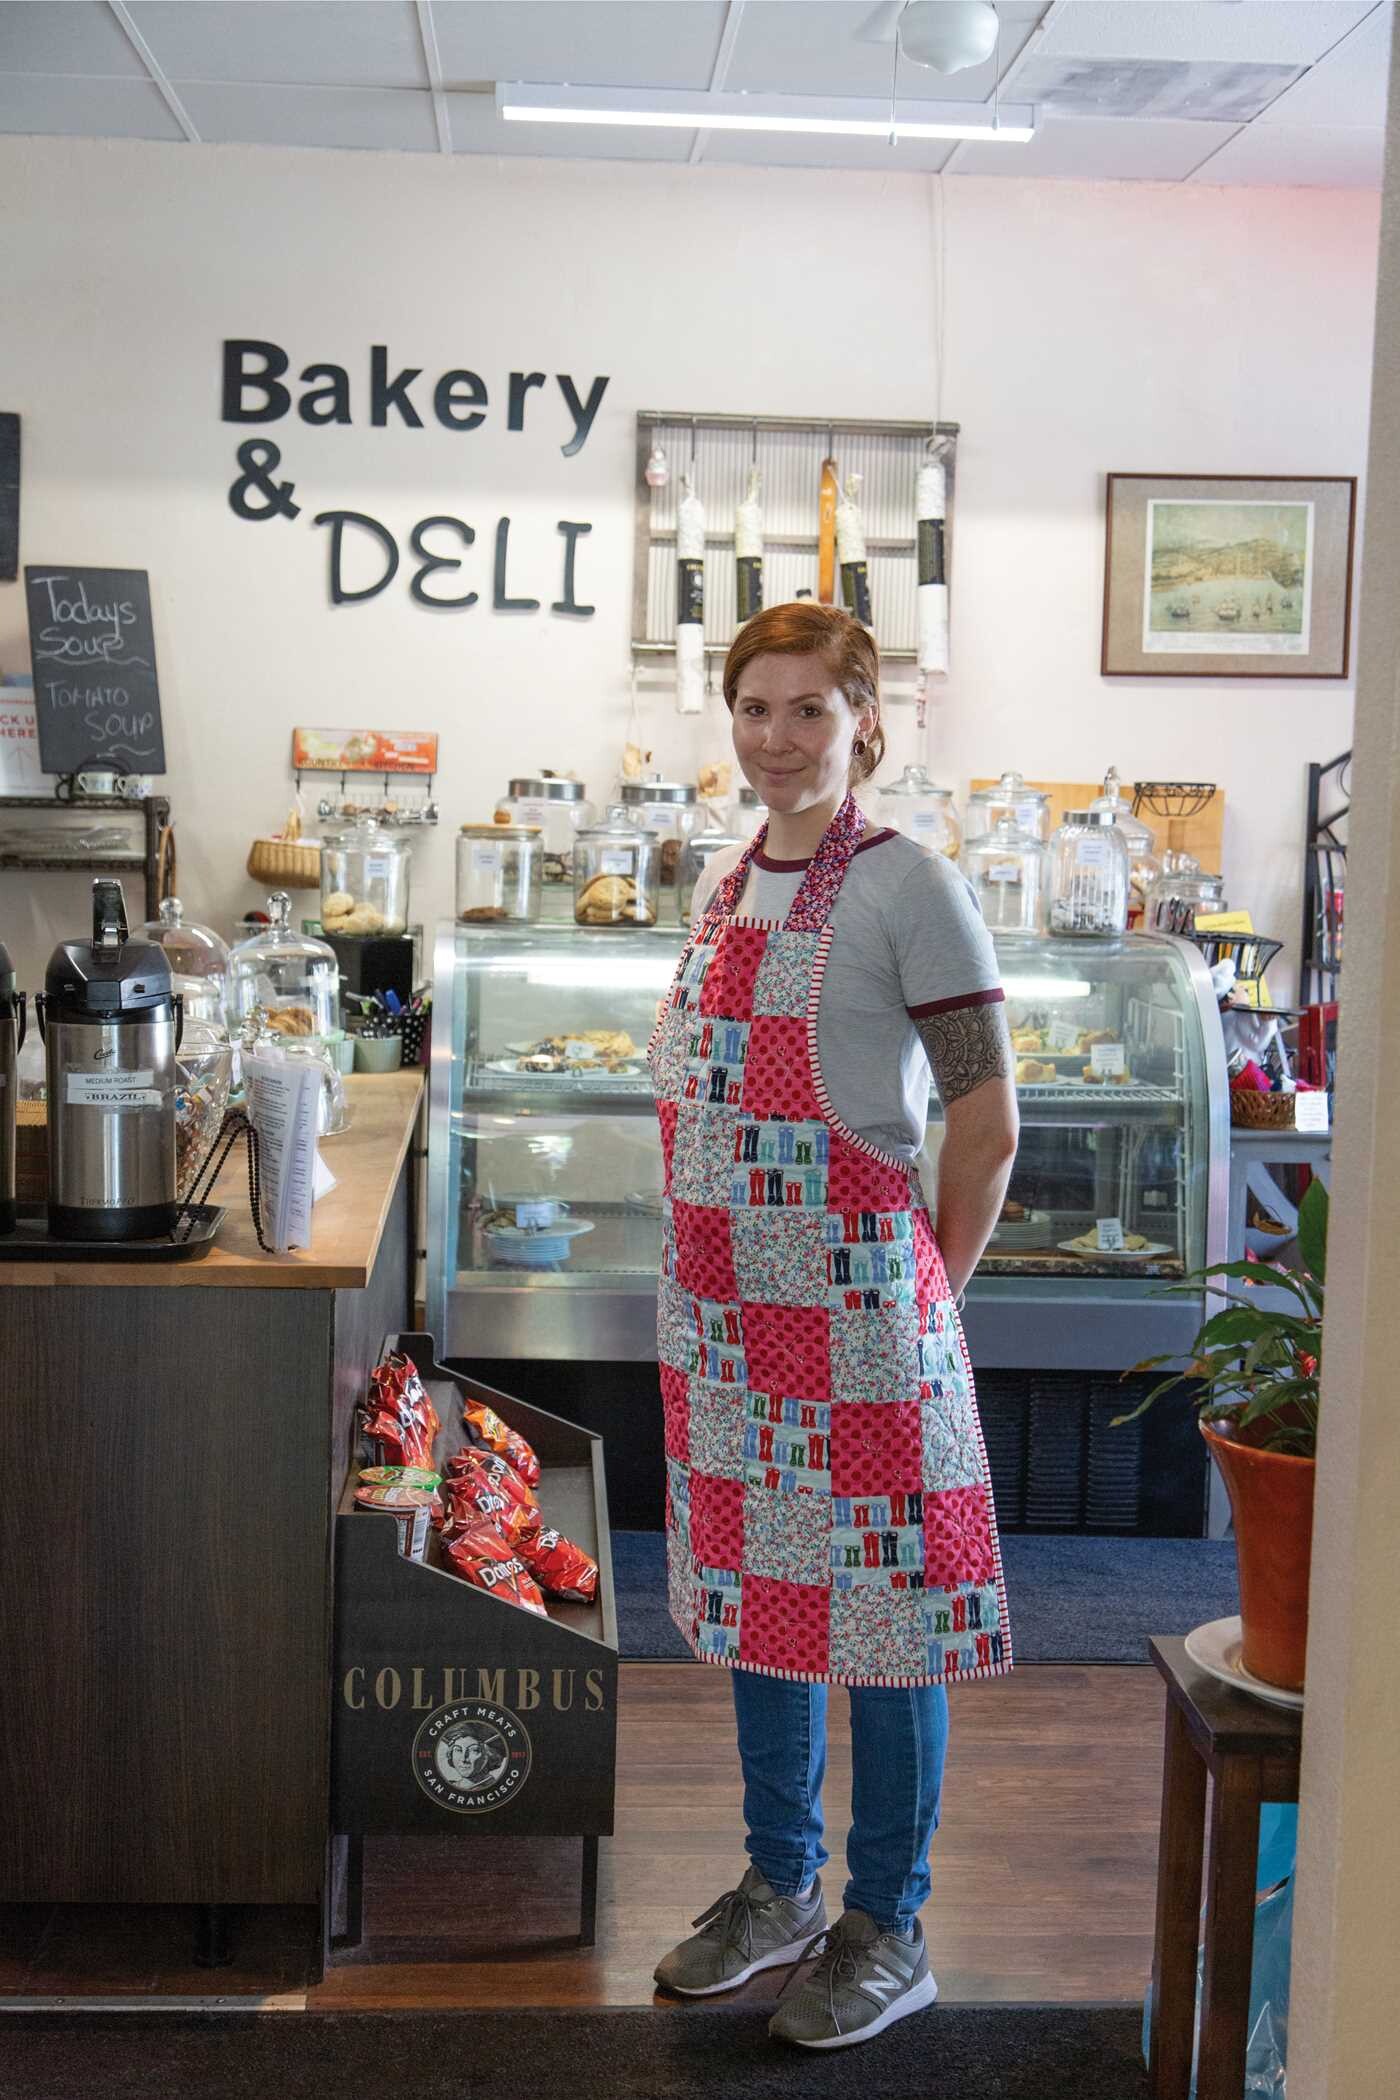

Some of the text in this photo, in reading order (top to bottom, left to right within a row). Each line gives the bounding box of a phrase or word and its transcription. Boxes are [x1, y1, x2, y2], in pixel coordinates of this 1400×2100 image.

[222, 339, 610, 458] Bakery
[228, 438, 301, 521] &
[314, 510, 595, 616] DELI
[84, 711, 153, 742] SOUP
[85, 1076, 137, 1085] MEDIUM ROAST
[91, 1093, 142, 1101] BRAZIL
[343, 1666, 605, 1711] COLUMBUS
[428, 1707, 518, 1738] CRAFT MEATS
[424, 1769, 520, 1806] SAN FRANCISCO
